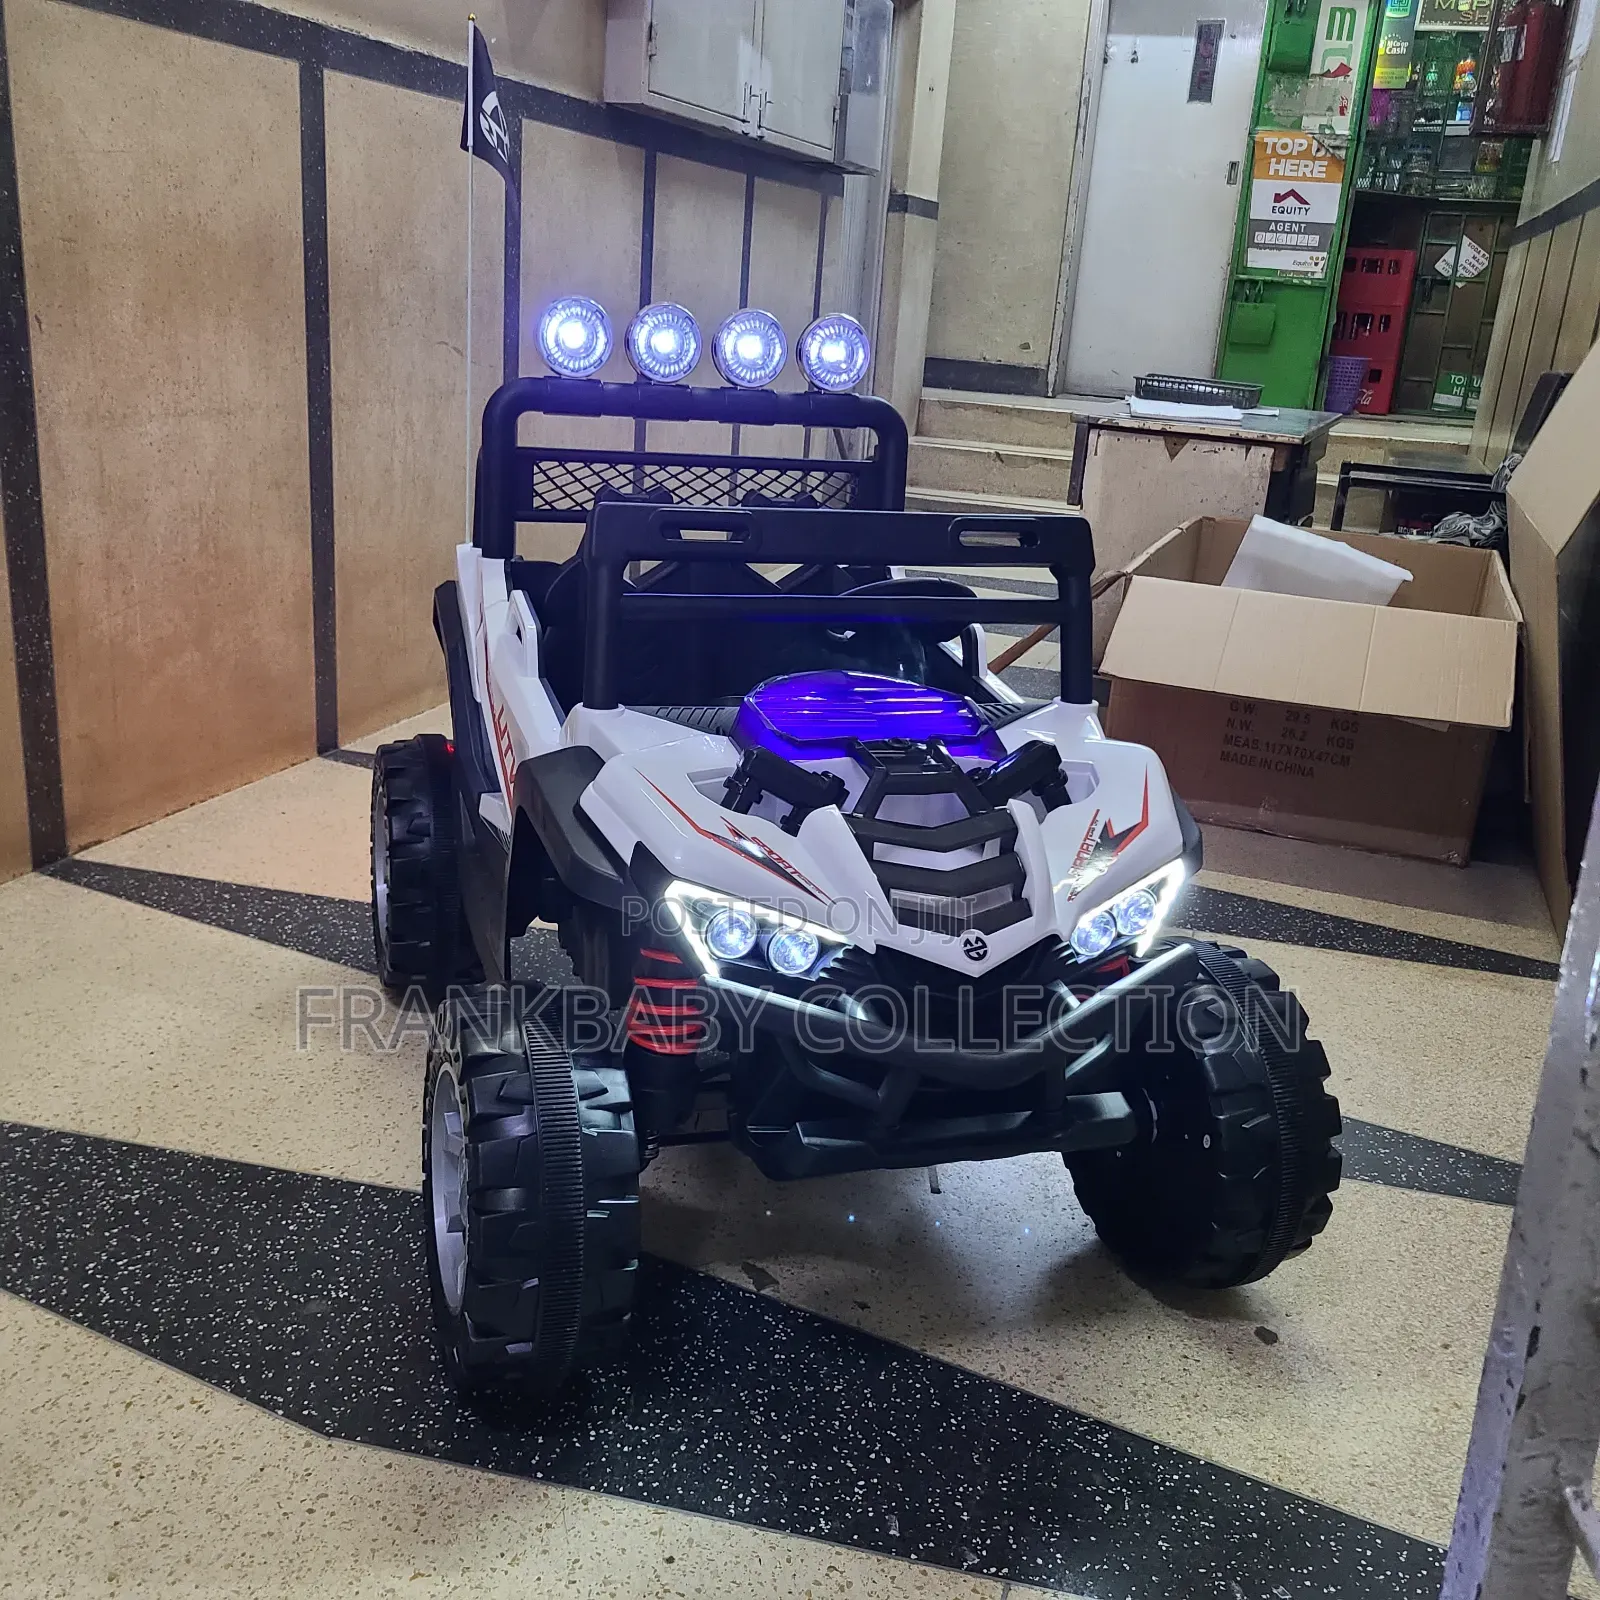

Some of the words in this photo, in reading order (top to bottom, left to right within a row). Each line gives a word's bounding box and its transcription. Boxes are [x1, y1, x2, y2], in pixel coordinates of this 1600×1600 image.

[1385, 46, 1407, 55] Cash
[1263, 137, 1308, 156] TOP
[1311, 139, 1332, 158] U
[1268, 158, 1328, 178] HERE
[1271, 205, 1311, 216] EQUITY
[1268, 222, 1307, 233] AGENT
[1330, 717, 1360, 734] KGS
[1326, 735, 1355, 751] KGS
[1220, 750, 1257, 767] MADE
[1259, 757, 1273, 770] IN
[1275, 760, 1315, 778] CHINA
